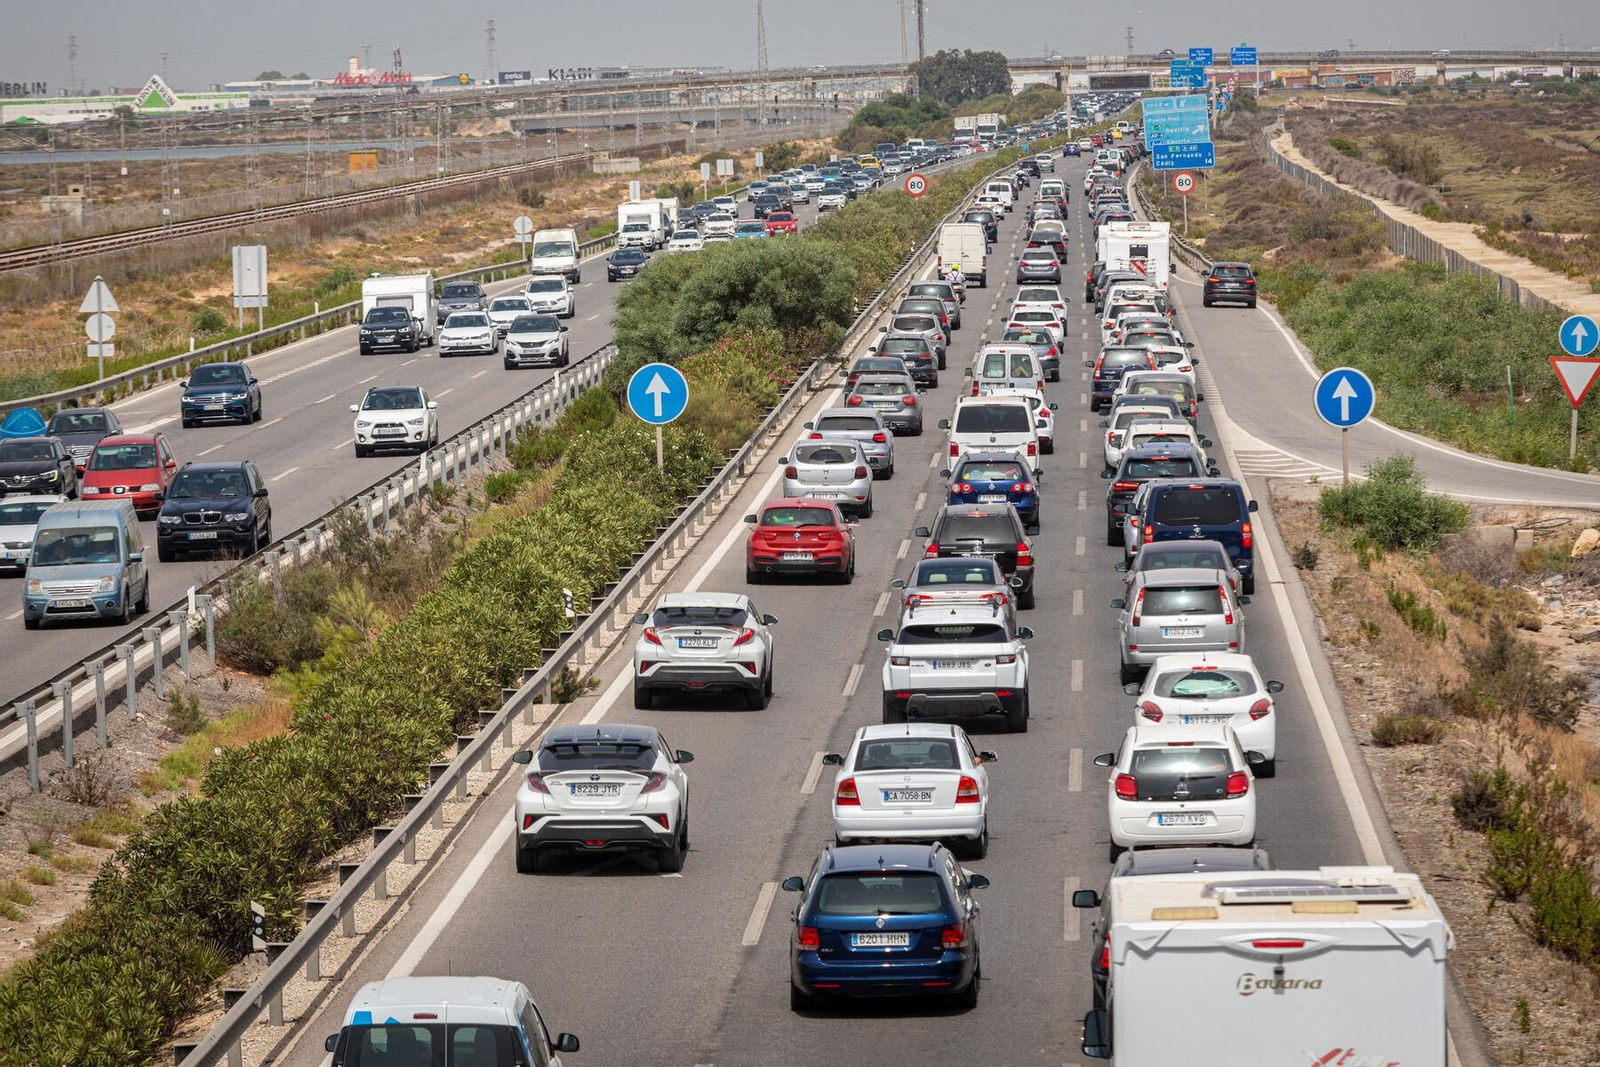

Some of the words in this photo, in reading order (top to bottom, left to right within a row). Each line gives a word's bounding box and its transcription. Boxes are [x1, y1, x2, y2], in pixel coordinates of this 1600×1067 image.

[135, 85, 153, 107] LEROY
[151, 77, 175, 107] MERLIN
[909, 181, 923, 190] 80
[1178, 178, 1191, 187] 80
[683, 638, 702, 646] 3270
[703, 639, 716, 647] KLP
[958, 661, 971, 669] JXS
[1190, 716, 1209, 724] 5112
[577, 784, 599, 794] 8229
[601, 784, 618, 794] JYR
[889, 791, 898, 800] CA
[1164, 814, 1186, 823] 2670
[1188, 814, 1205, 823] KVG
[859, 934, 884, 944] 6201
[886, 934, 907, 944] HHN
[1237, 973, 1323, 997] Bavaria
